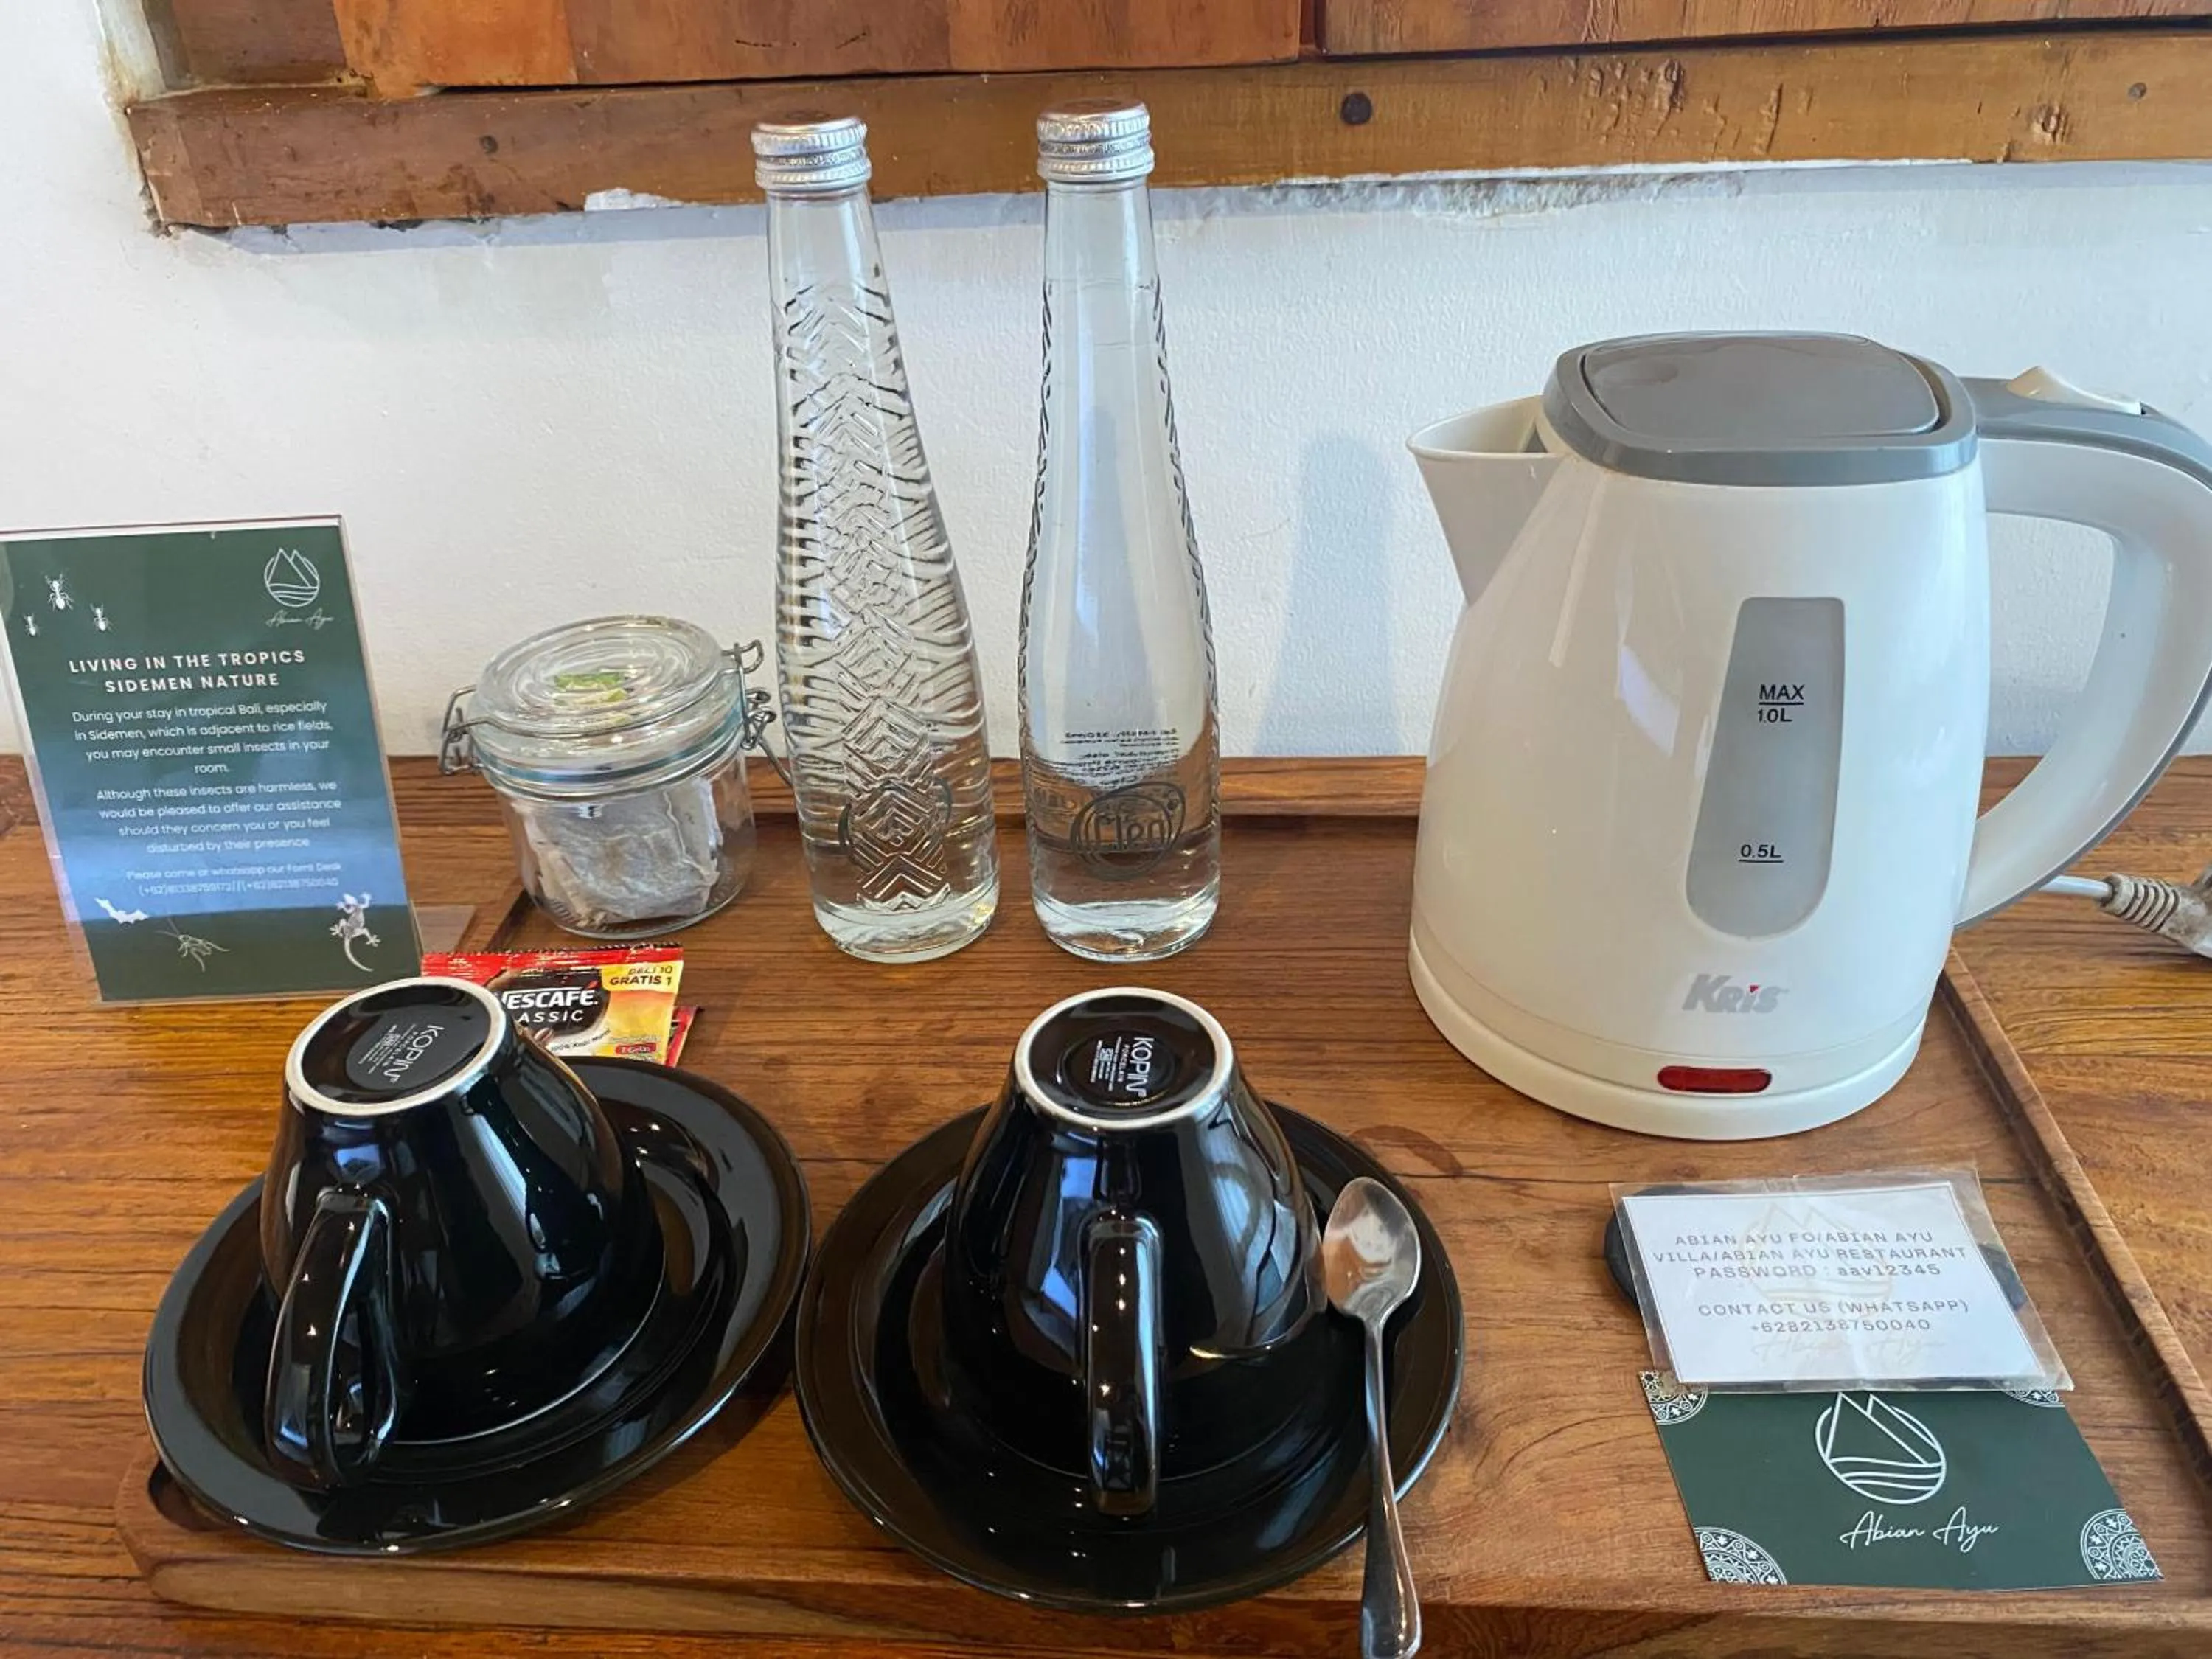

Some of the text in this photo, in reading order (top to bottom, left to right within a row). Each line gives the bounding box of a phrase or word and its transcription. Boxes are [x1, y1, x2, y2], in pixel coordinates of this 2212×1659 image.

[69, 650, 305, 673] LIVING IN THE TROPICS
[104, 672, 279, 693] SIDEMEN NATURE
[1759, 684, 1806, 700] MAX
[72, 700, 327, 723] During your stay in tropical Bali, especially
[74, 730, 86, 741] in
[88, 728, 147, 741] Sidemen,
[147, 726, 185, 737] which
[186, 725, 198, 736] is
[200, 723, 255, 737] adjacent
[257, 723, 270, 733] to
[272, 720, 296, 732] rice
[86, 739, 330, 763] you may encounter small insects in your
[194, 763, 230, 773] room.
[97, 781, 338, 801] Although these insects are harmless, we
[98, 799, 342, 819] would be pleased to offer our assistance
[118, 817, 330, 836] should they concern you or you feel
[146, 838, 310, 853] disturbed by their presence
[1739, 844, 1782, 859] 0.5L
[660, 965, 673, 974] 10
[609, 975, 672, 987] GRATIS 1
[518, 1009, 584, 1023] ASSIC
[1675, 1234, 1737, 1246] ABIAN
[1745, 1233, 1783, 1245] AYU
[1895, 1230, 1933, 1243] AYU
[1792, 1248, 1830, 1260] AYU
[1837, 1246, 1966, 1260] RESTAURANT
[1694, 1265, 1818, 1278] PASSWORD
[1837, 1262, 1941, 1276] aav12345
[1698, 1298, 1969, 1316] CONTACT US (WHATSAPP)
[1839, 1506, 2000, 1554] Abian Ayu
